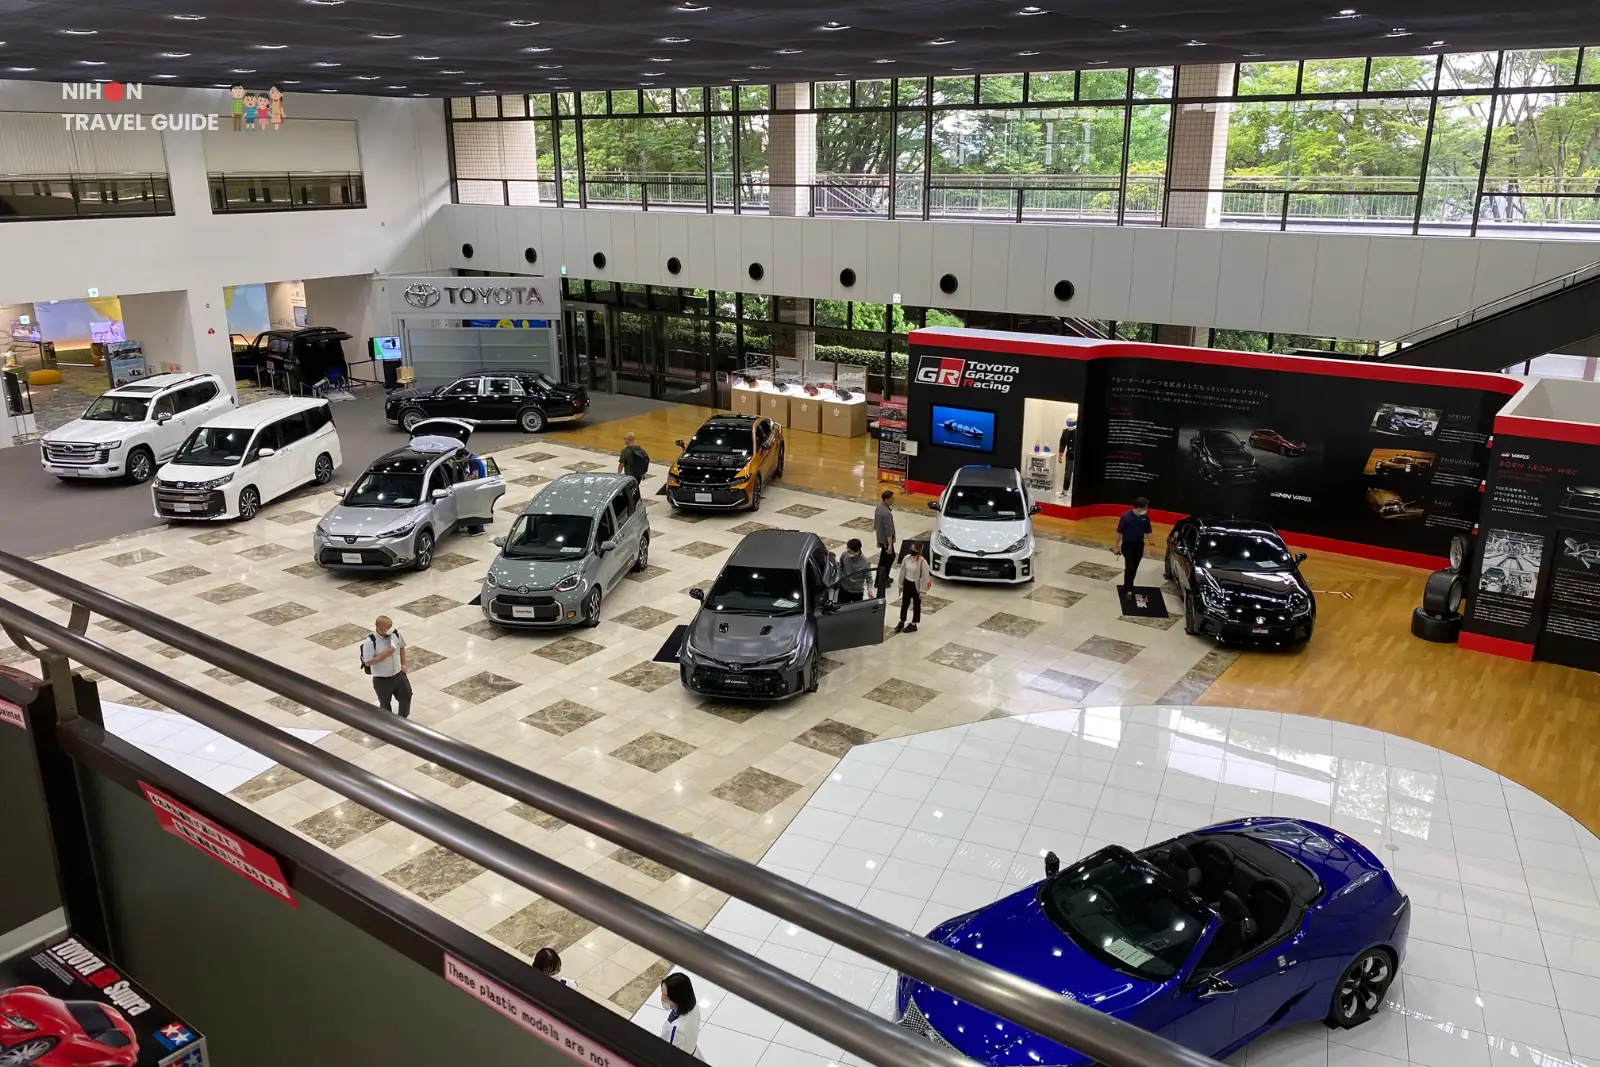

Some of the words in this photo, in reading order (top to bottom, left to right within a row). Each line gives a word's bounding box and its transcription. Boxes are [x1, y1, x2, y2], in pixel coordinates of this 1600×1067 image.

[444, 285, 544, 305] TOYOTA
[967, 361, 1019, 374] TOYOTA
[918, 367, 960, 385] GR
[965, 370, 1014, 382] GAZOO
[962, 379, 1011, 394] Racing
[1448, 413, 1471, 421] SPRINT
[1441, 457, 1480, 467] ENDURANCE
[1499, 461, 1524, 469] BORN
[1528, 463, 1553, 472] FROM
[1557, 467, 1579, 476] WRC
[51, 937, 106, 977] TOYOTA
[103, 980, 151, 1017] Supra
[447, 961, 476, 989] These
[480, 985, 517, 1016] plastic
[521, 1011, 560, 1042] models
[564, 1037, 585, 1056] are
[590, 1051, 610, 1067] not
